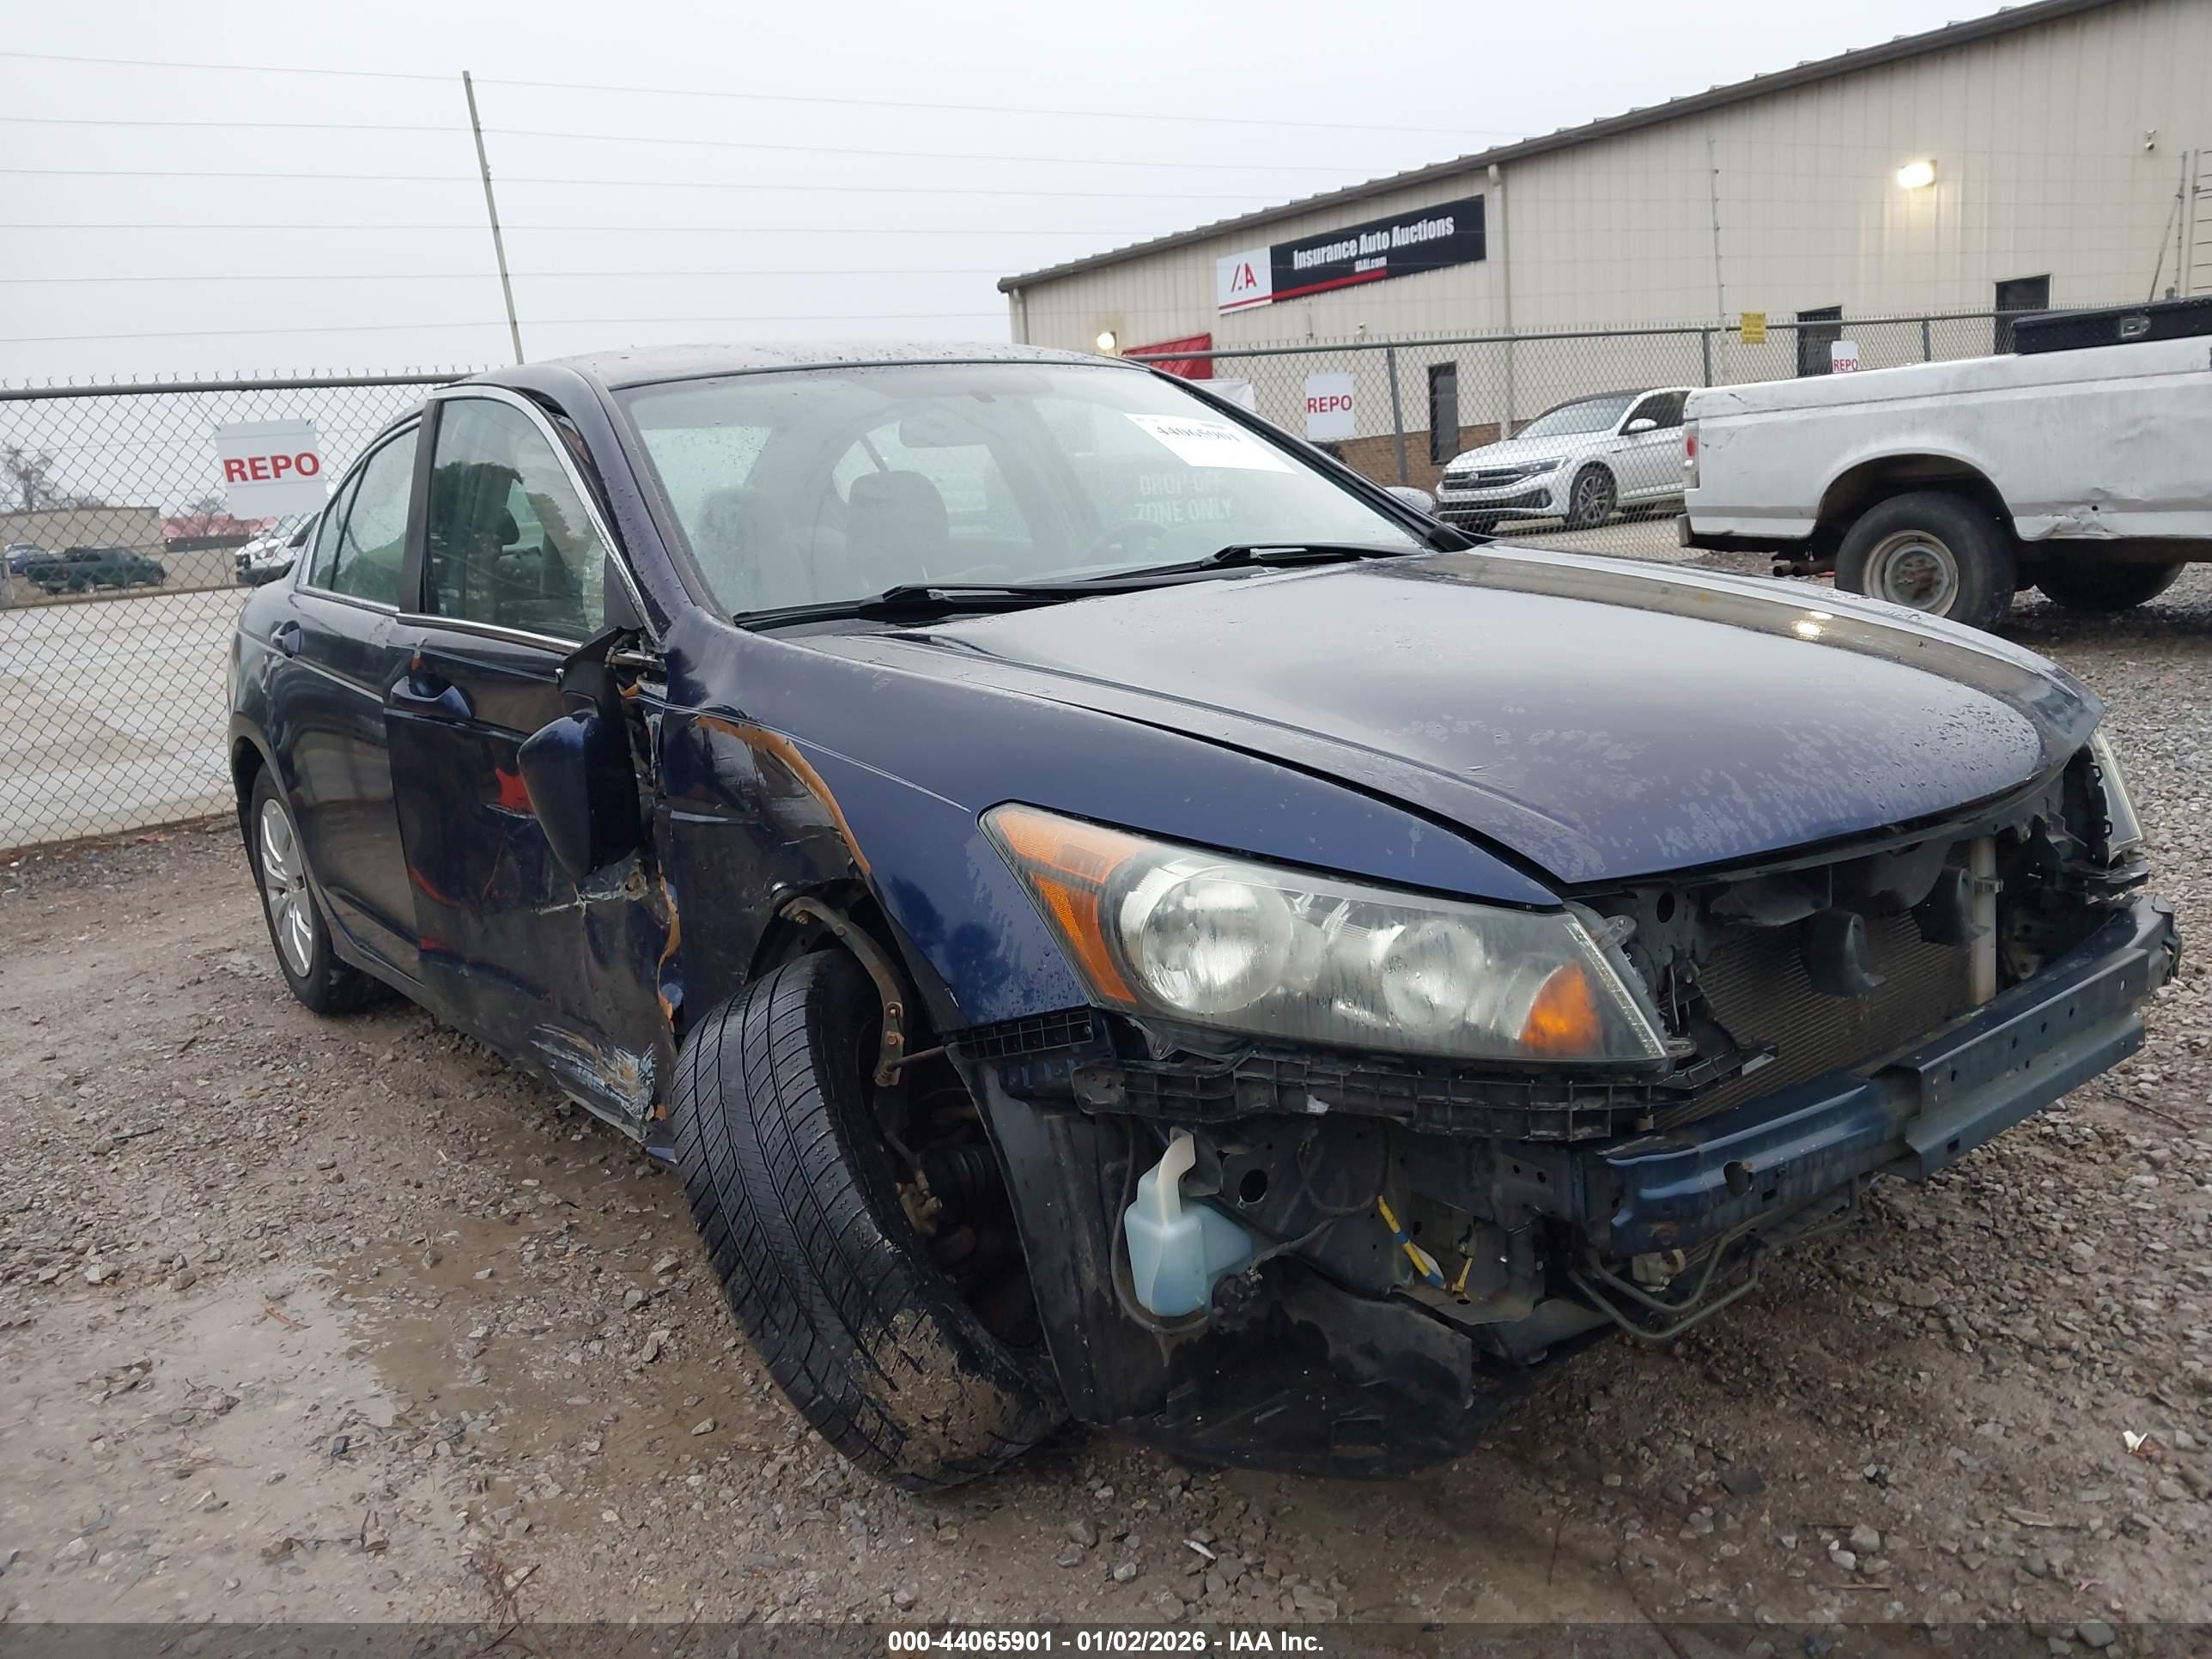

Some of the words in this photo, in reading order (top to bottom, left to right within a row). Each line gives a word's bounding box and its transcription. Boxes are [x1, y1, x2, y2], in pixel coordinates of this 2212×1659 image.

[1293, 239, 1358, 270] Insurance
[1358, 232, 1390, 255] Auto
[1391, 216, 1455, 247] Auctions
[1833, 357, 1858, 372] REPO
[1307, 394, 1352, 414] REPO
[222, 452, 320, 483] REPO
[1139, 472, 1188, 496] DROP
[1133, 500, 1185, 523] ZONE
[1188, 496, 1231, 521] ONLY
